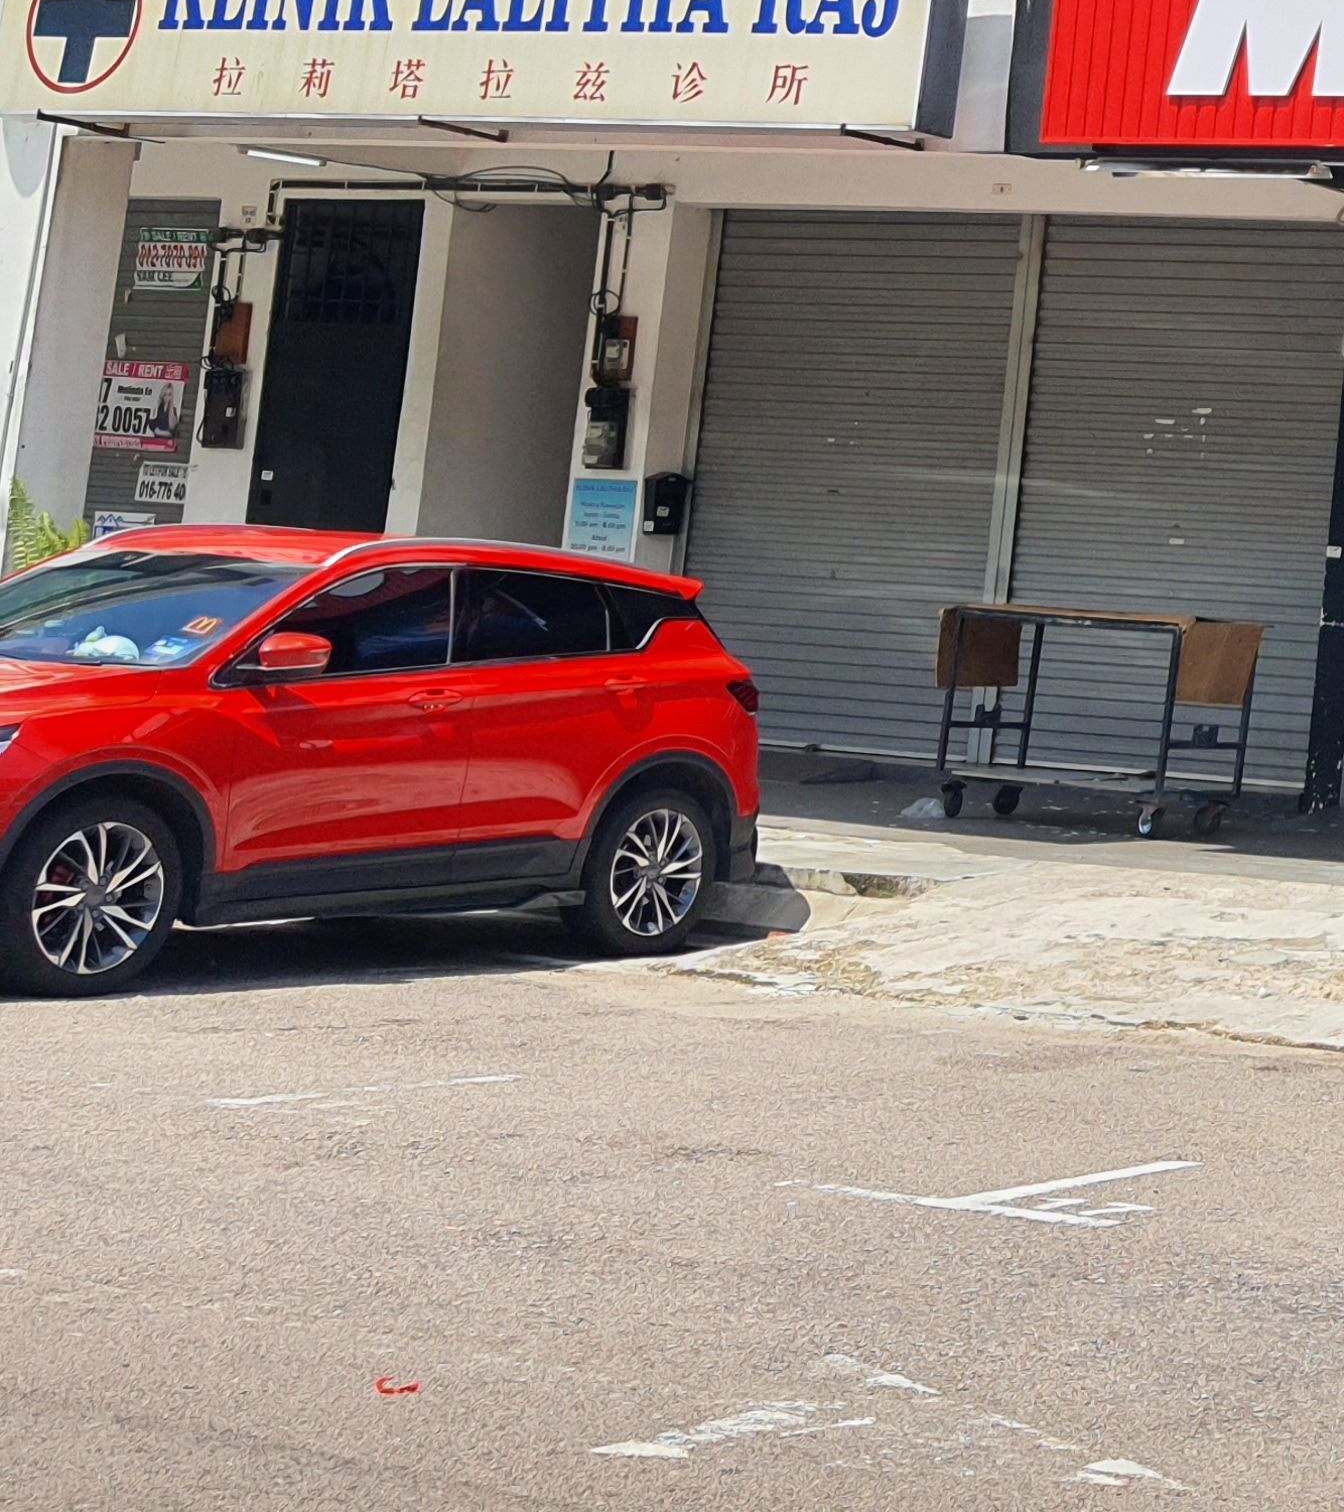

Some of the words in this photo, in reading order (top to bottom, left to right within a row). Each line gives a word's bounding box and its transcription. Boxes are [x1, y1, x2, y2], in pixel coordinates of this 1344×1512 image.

[212, 57, 809, 106] 拉莉塔拉兹诊所
[105, 359, 130, 376] SALE
[138, 363, 165, 378] RENT
[111, 405, 151, 435] 0057
